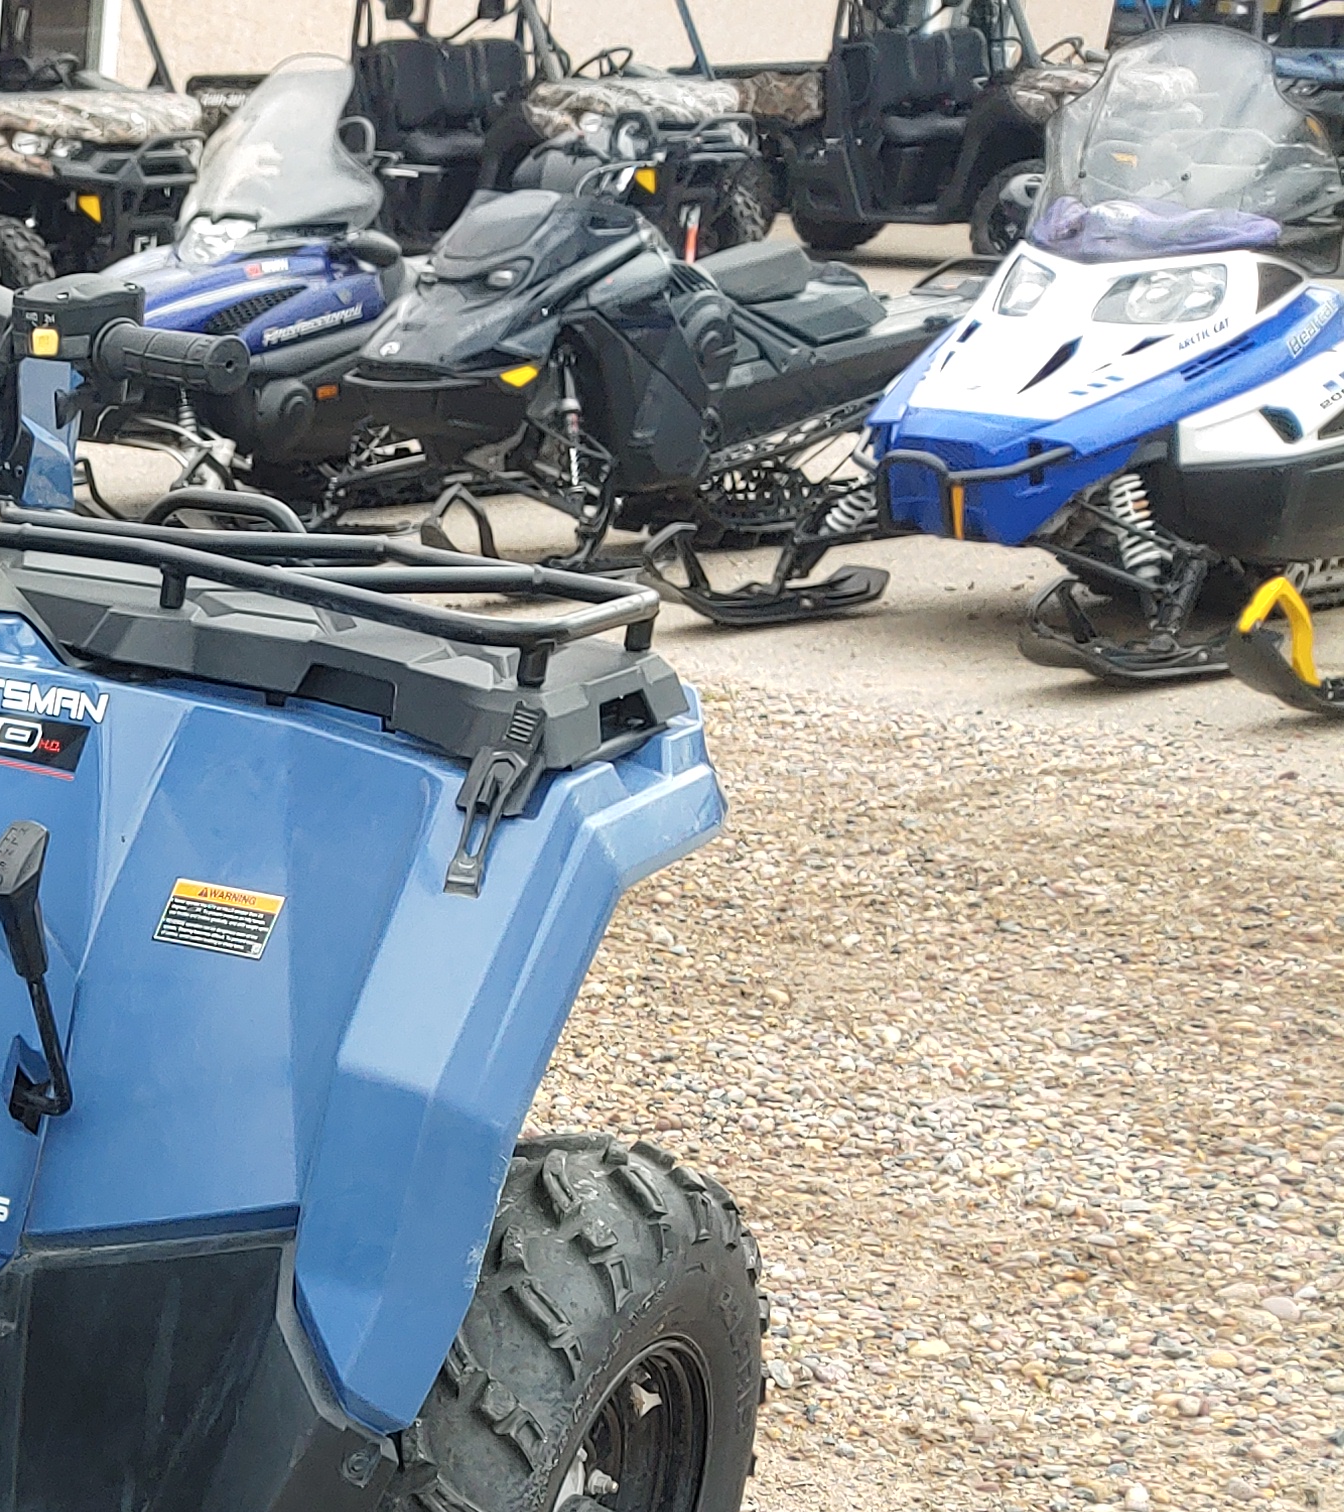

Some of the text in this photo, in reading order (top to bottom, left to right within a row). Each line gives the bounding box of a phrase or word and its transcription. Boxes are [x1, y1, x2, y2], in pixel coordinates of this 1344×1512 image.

[1178, 317, 1230, 350] ARCTIC CAT
[208, 886, 257, 907] WARNING
